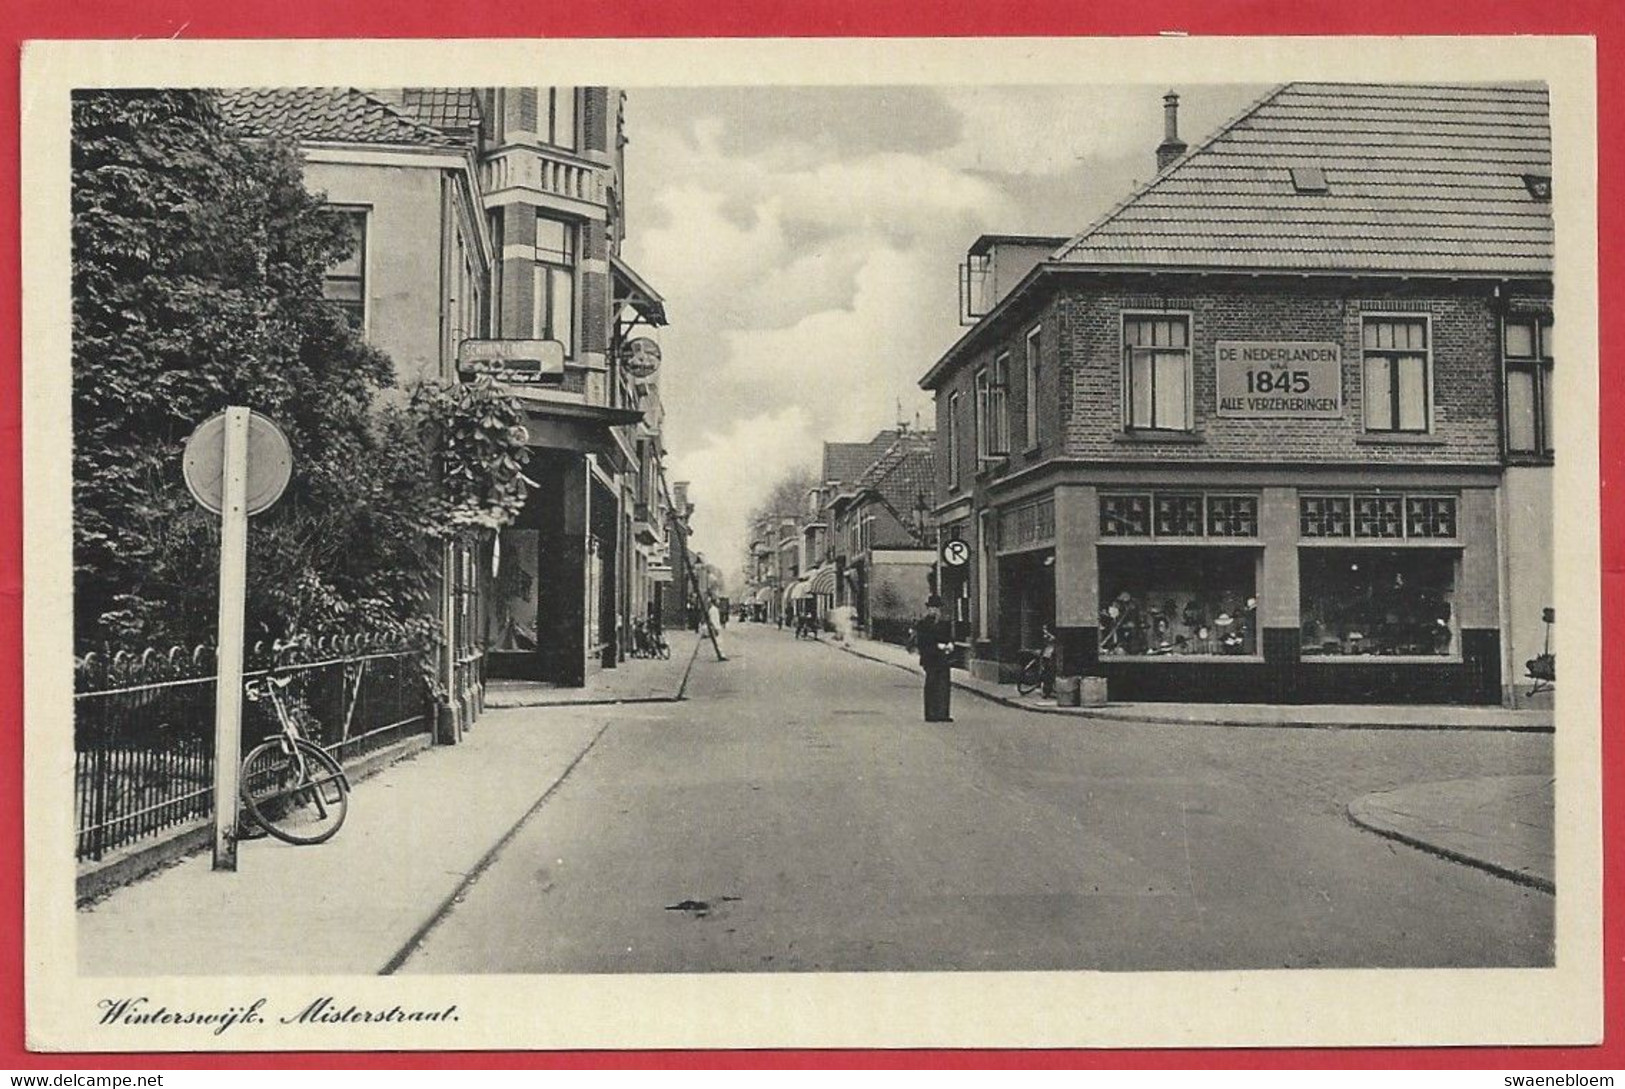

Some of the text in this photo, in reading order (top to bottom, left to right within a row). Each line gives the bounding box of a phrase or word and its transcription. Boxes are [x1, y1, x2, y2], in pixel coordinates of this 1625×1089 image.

[1220, 348, 1337, 362] DE NEDERLANDEN
[1246, 370, 1310, 393] 1845
[1220, 397, 1338, 412] ALLE VERZEKERINGEN
